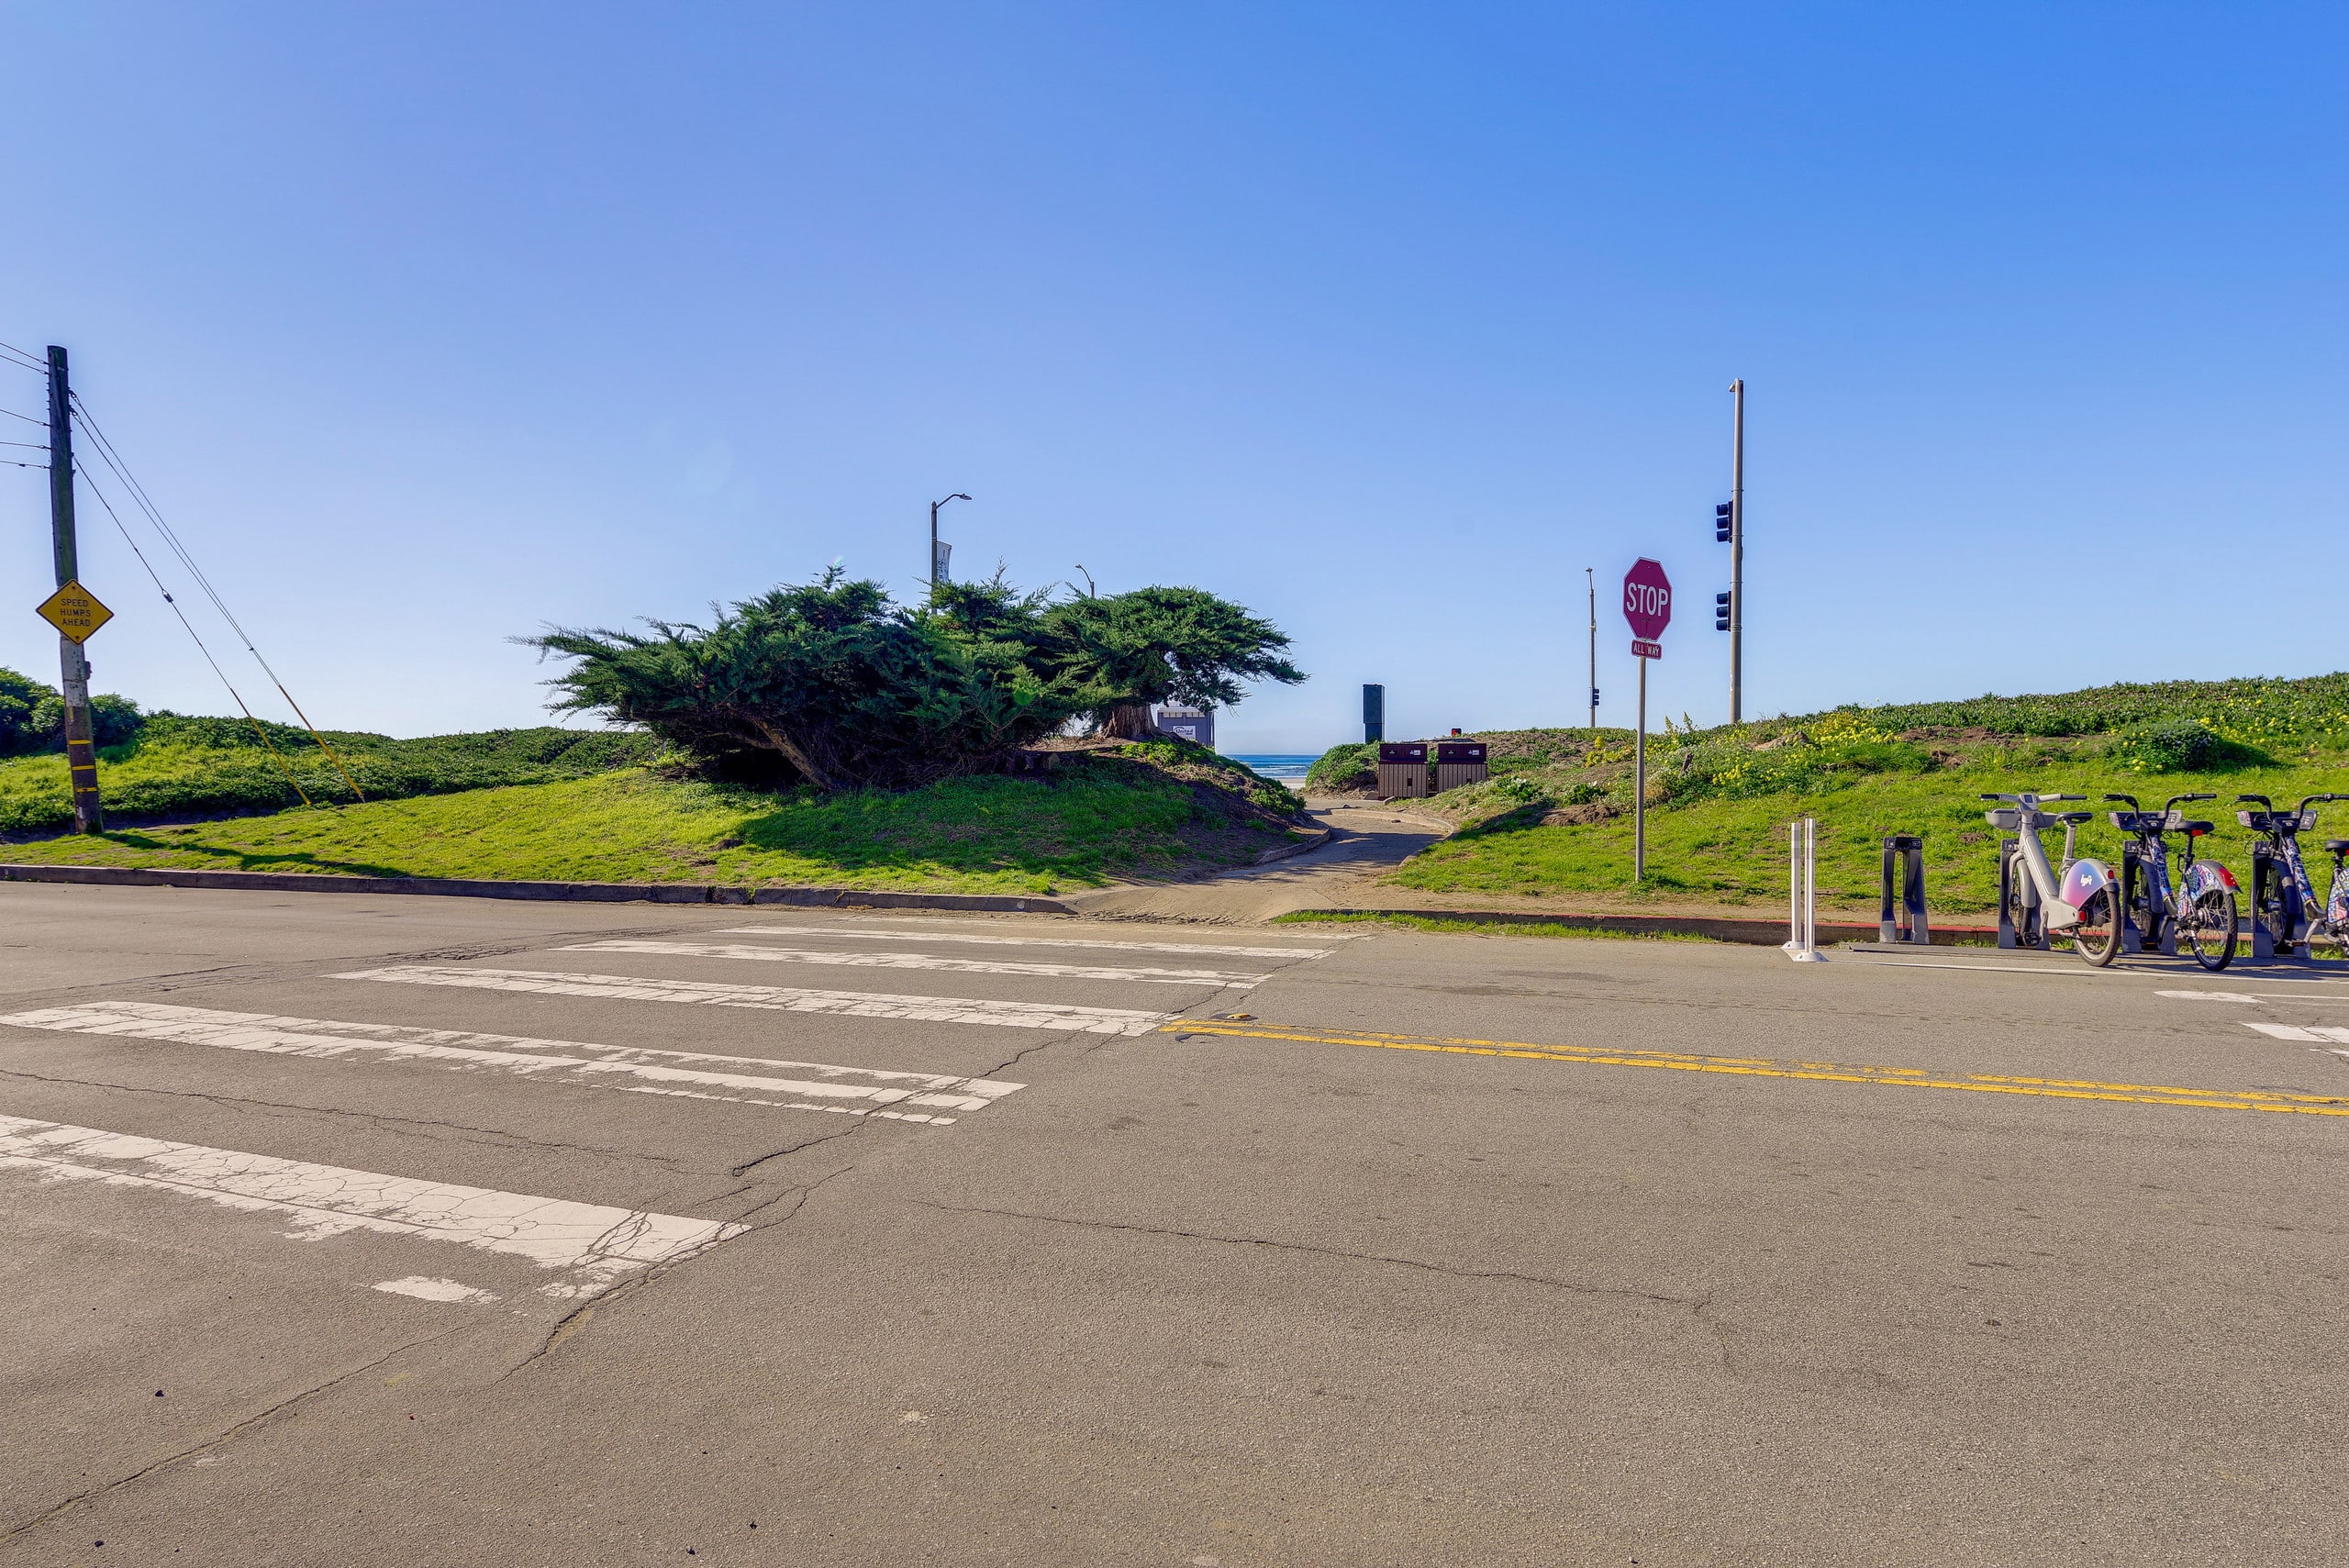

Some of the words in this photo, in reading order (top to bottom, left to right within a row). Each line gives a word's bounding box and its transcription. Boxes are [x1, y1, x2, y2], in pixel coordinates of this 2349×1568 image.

[61, 598, 88, 606] SPEED
[1626, 582, 1668, 617] STOP
[60, 608, 91, 617] HUMPS
[61, 618, 91, 627] AHEAD
[1633, 643, 1644, 654] ALL
[1647, 645, 1660, 656] WAY
